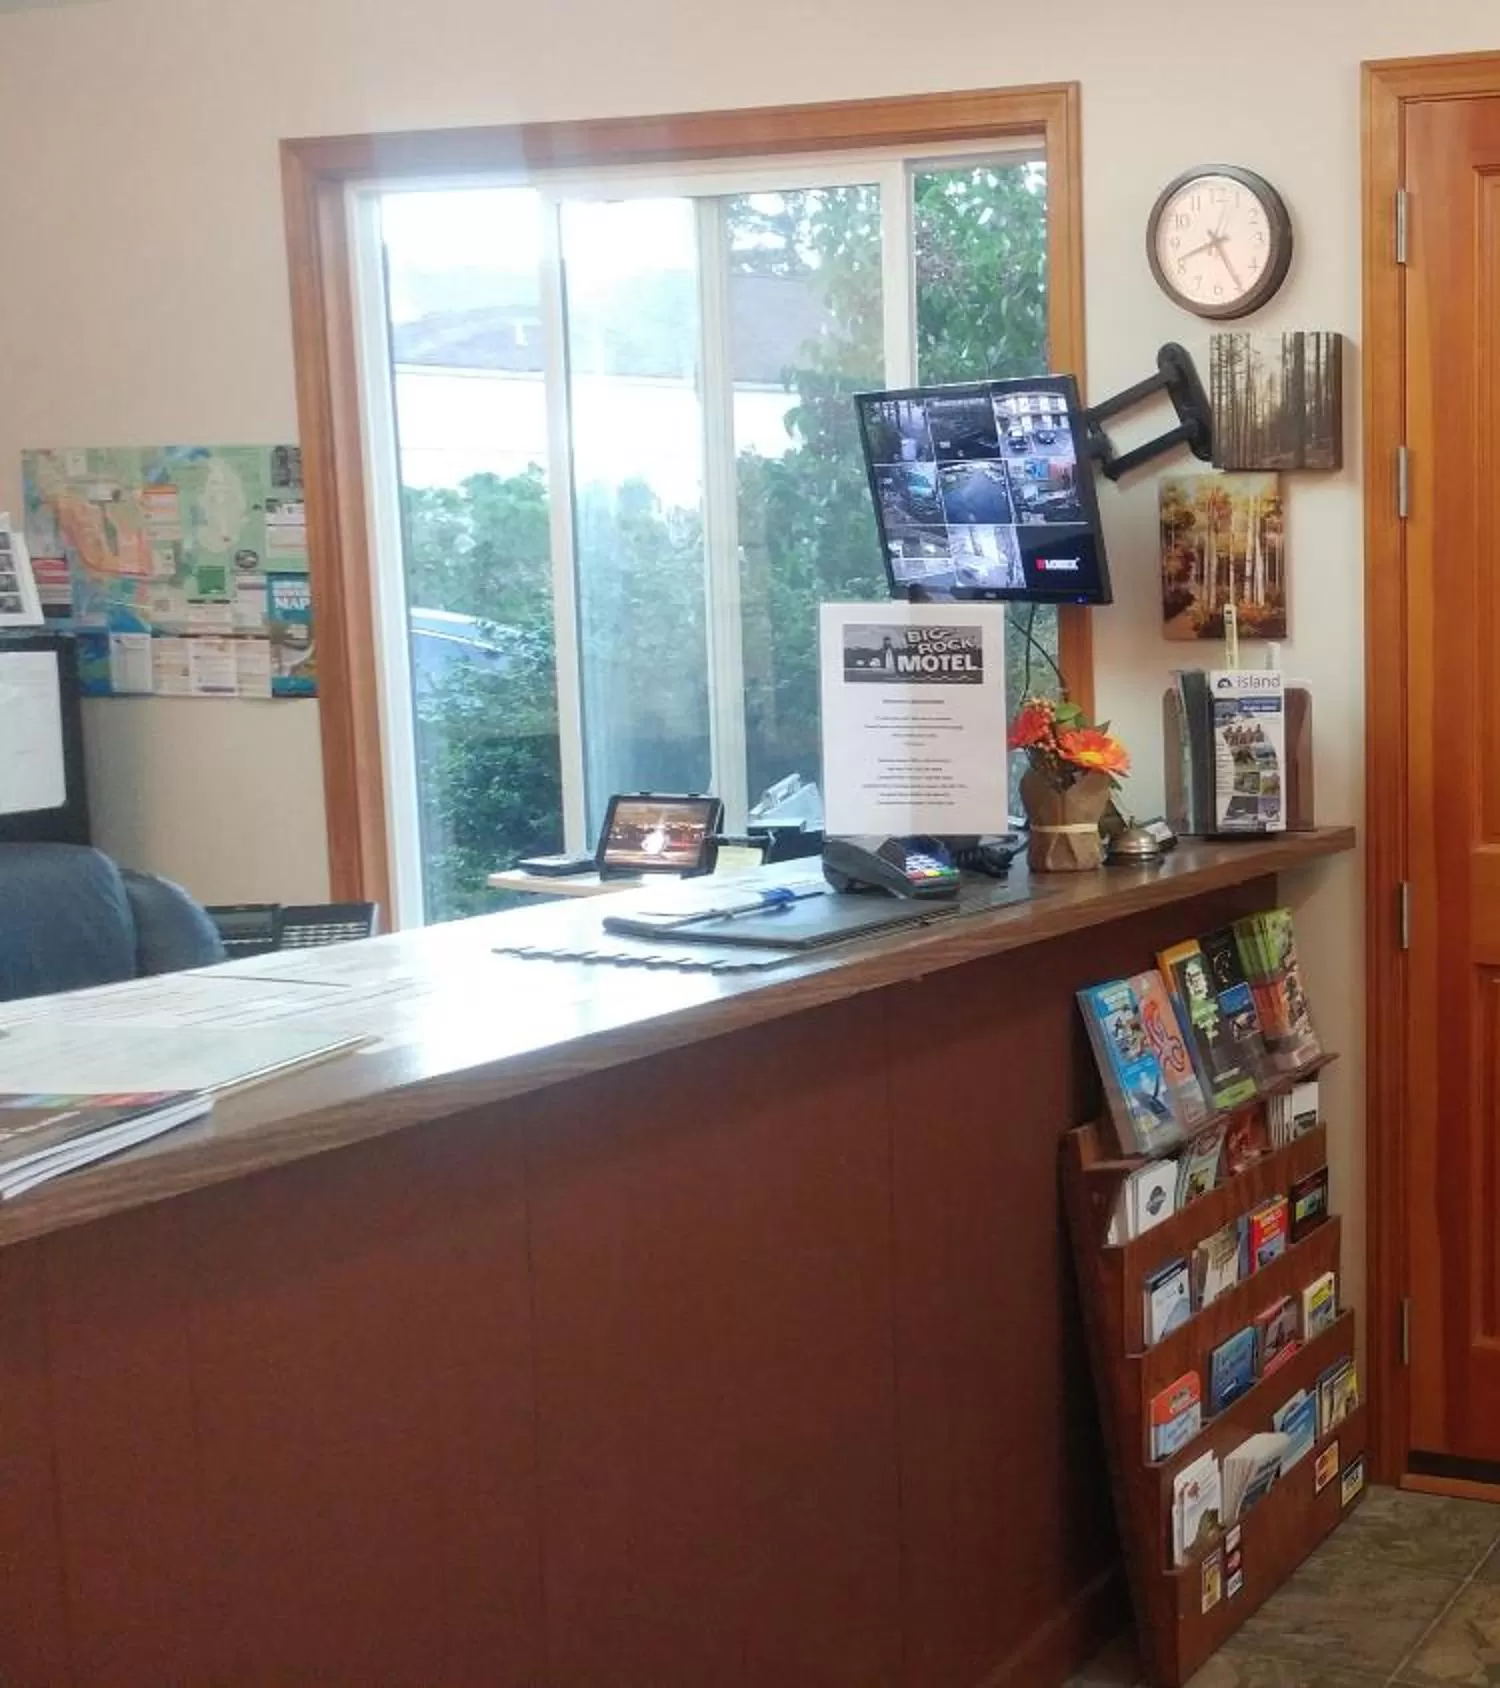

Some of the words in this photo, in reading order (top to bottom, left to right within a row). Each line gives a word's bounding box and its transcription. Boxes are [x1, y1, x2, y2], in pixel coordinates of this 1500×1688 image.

[907, 627, 949, 643] BIG
[918, 638, 976, 655] ROCK
[897, 653, 979, 673] MOTEL
[1237, 673, 1281, 689] island
